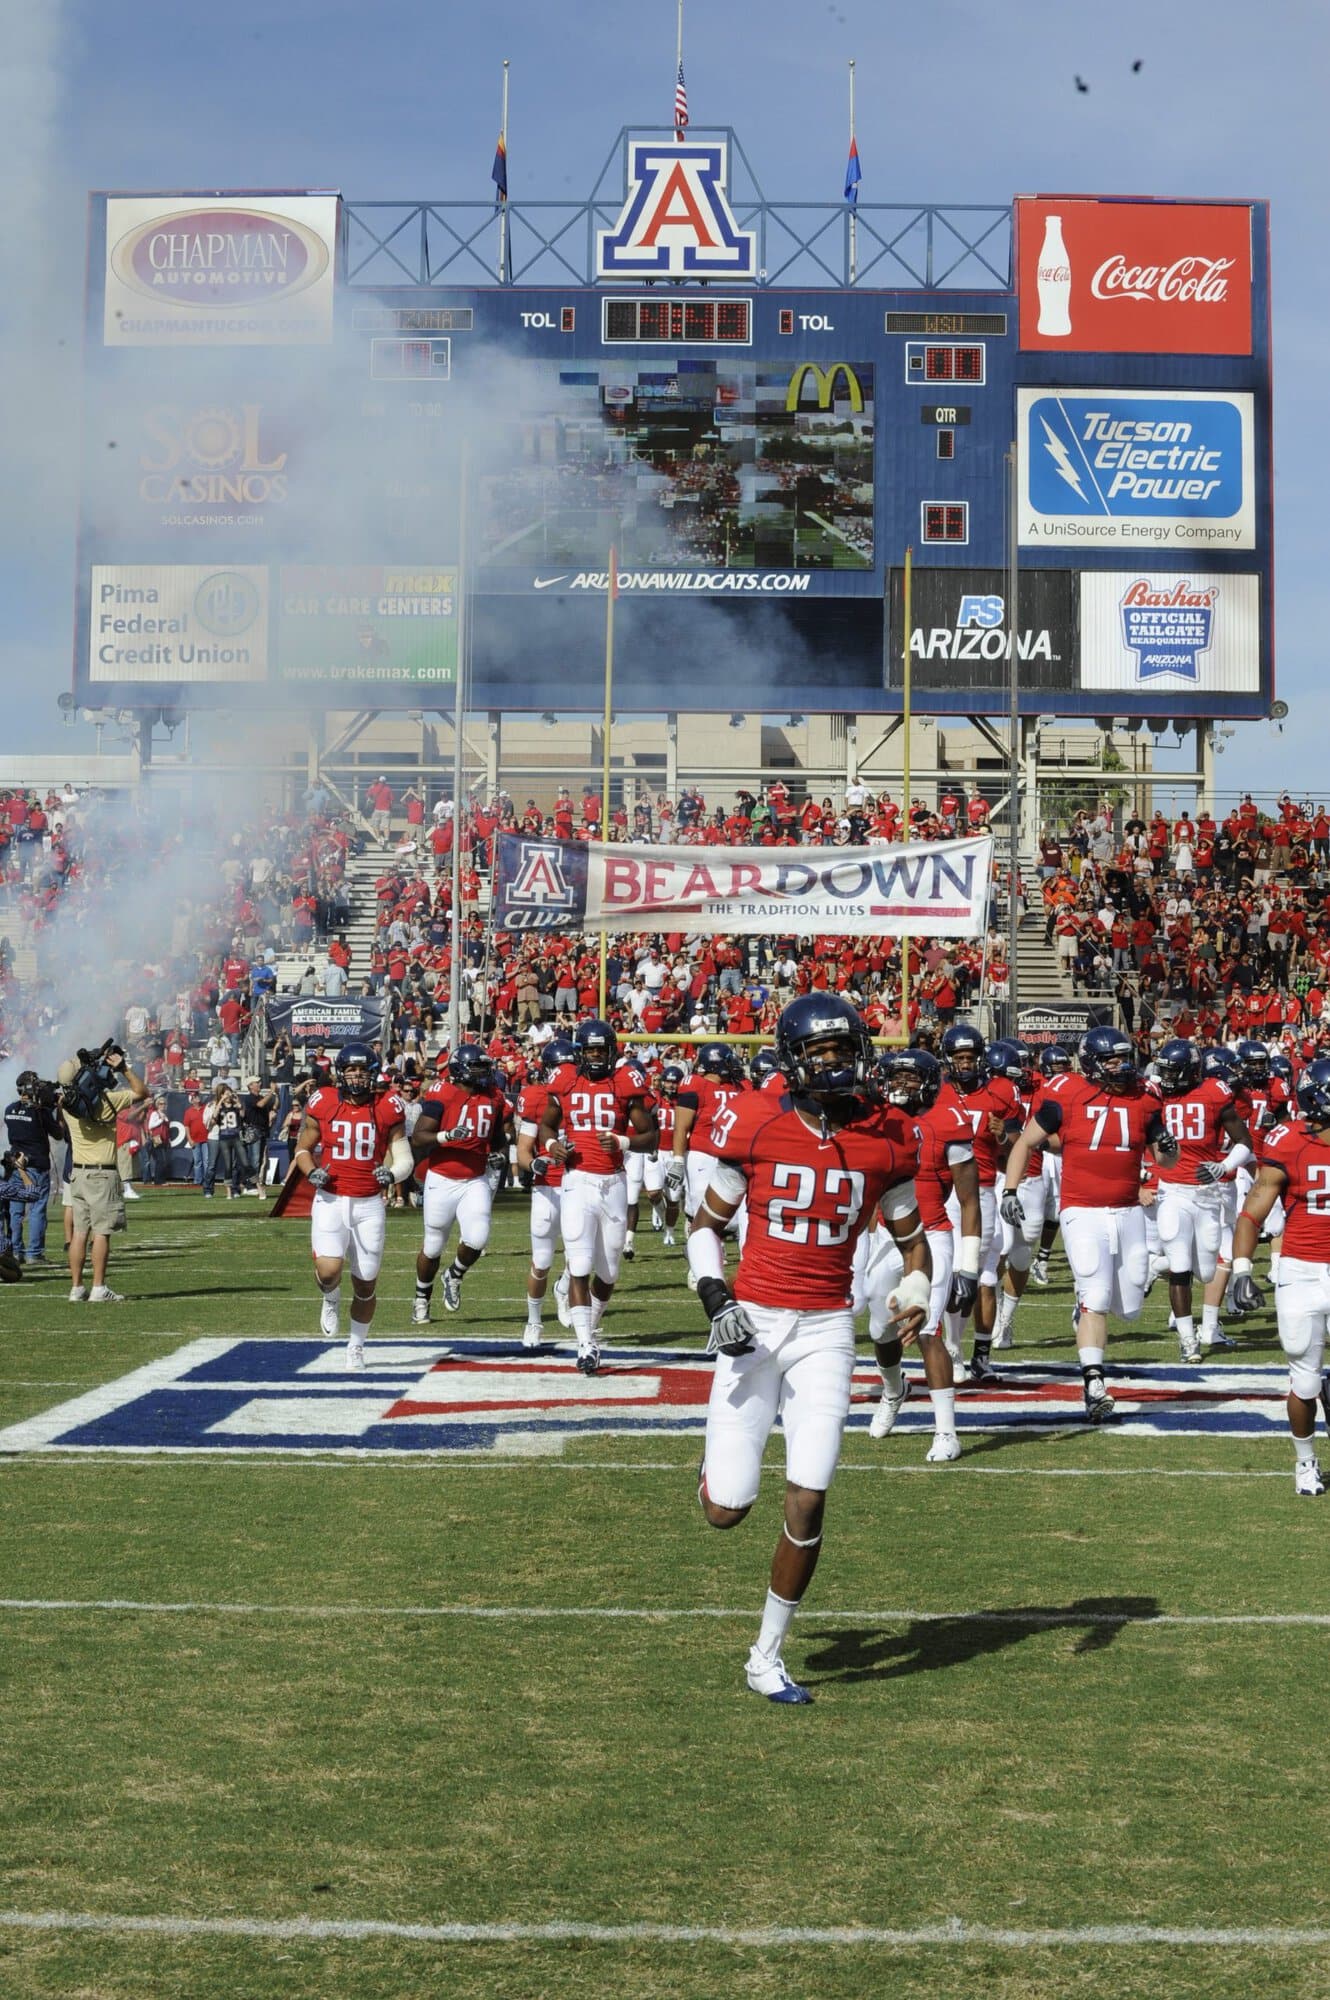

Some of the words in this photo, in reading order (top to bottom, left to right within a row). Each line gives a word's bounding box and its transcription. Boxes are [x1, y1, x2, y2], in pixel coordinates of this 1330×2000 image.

[149, 233, 290, 269] CHAPMAN
[153, 271, 287, 285] AUTOMOTIVE
[1090, 255, 1237, 302] Coca-Cola
[520, 312, 556, 329] TOL
[798, 314, 834, 331] TOL
[935, 407, 957, 423] QTR
[1083, 412, 1193, 443] Tucson
[1094, 442, 1222, 471] Electric
[139, 475, 288, 504] CASINOS
[1107, 471, 1222, 500] Power
[1028, 522, 1039, 535] A
[1044, 523, 1117, 537] UniSource
[1121, 524, 1171, 540] Energy
[1174, 525, 1243, 541] Company
[100, 584, 159, 604] Pima
[1123, 582, 1216, 607] Bashas'
[377, 597, 453, 616] CENTERS
[99, 613, 188, 634] Federal
[1129, 612, 1206, 624] OFFICIAL
[1129, 625, 1205, 637] TAILGATE
[1130, 638, 1205, 646] HEADQUARTERS
[99, 644, 172, 665] Credit
[178, 644, 250, 665] Union
[1143, 655, 1194, 664] ARIZONA
[283, 664, 452, 681] www.brakemax.com
[708, 904, 737, 915] THE
[740, 904, 820, 916] TRADITION
[826, 904, 866, 916] LIVES
[292, 1008, 332, 1016] AMERICAN
[333, 1008, 361, 1016] FAMILY
[458, 1104, 493, 1138] 46
[570, 1093, 616, 1132] 26
[1165, 1102, 1206, 1141] 83
[1086, 1105, 1131, 1152] 71
[331, 1120, 376, 1161] 38
[766, 1162, 866, 1248] 23
